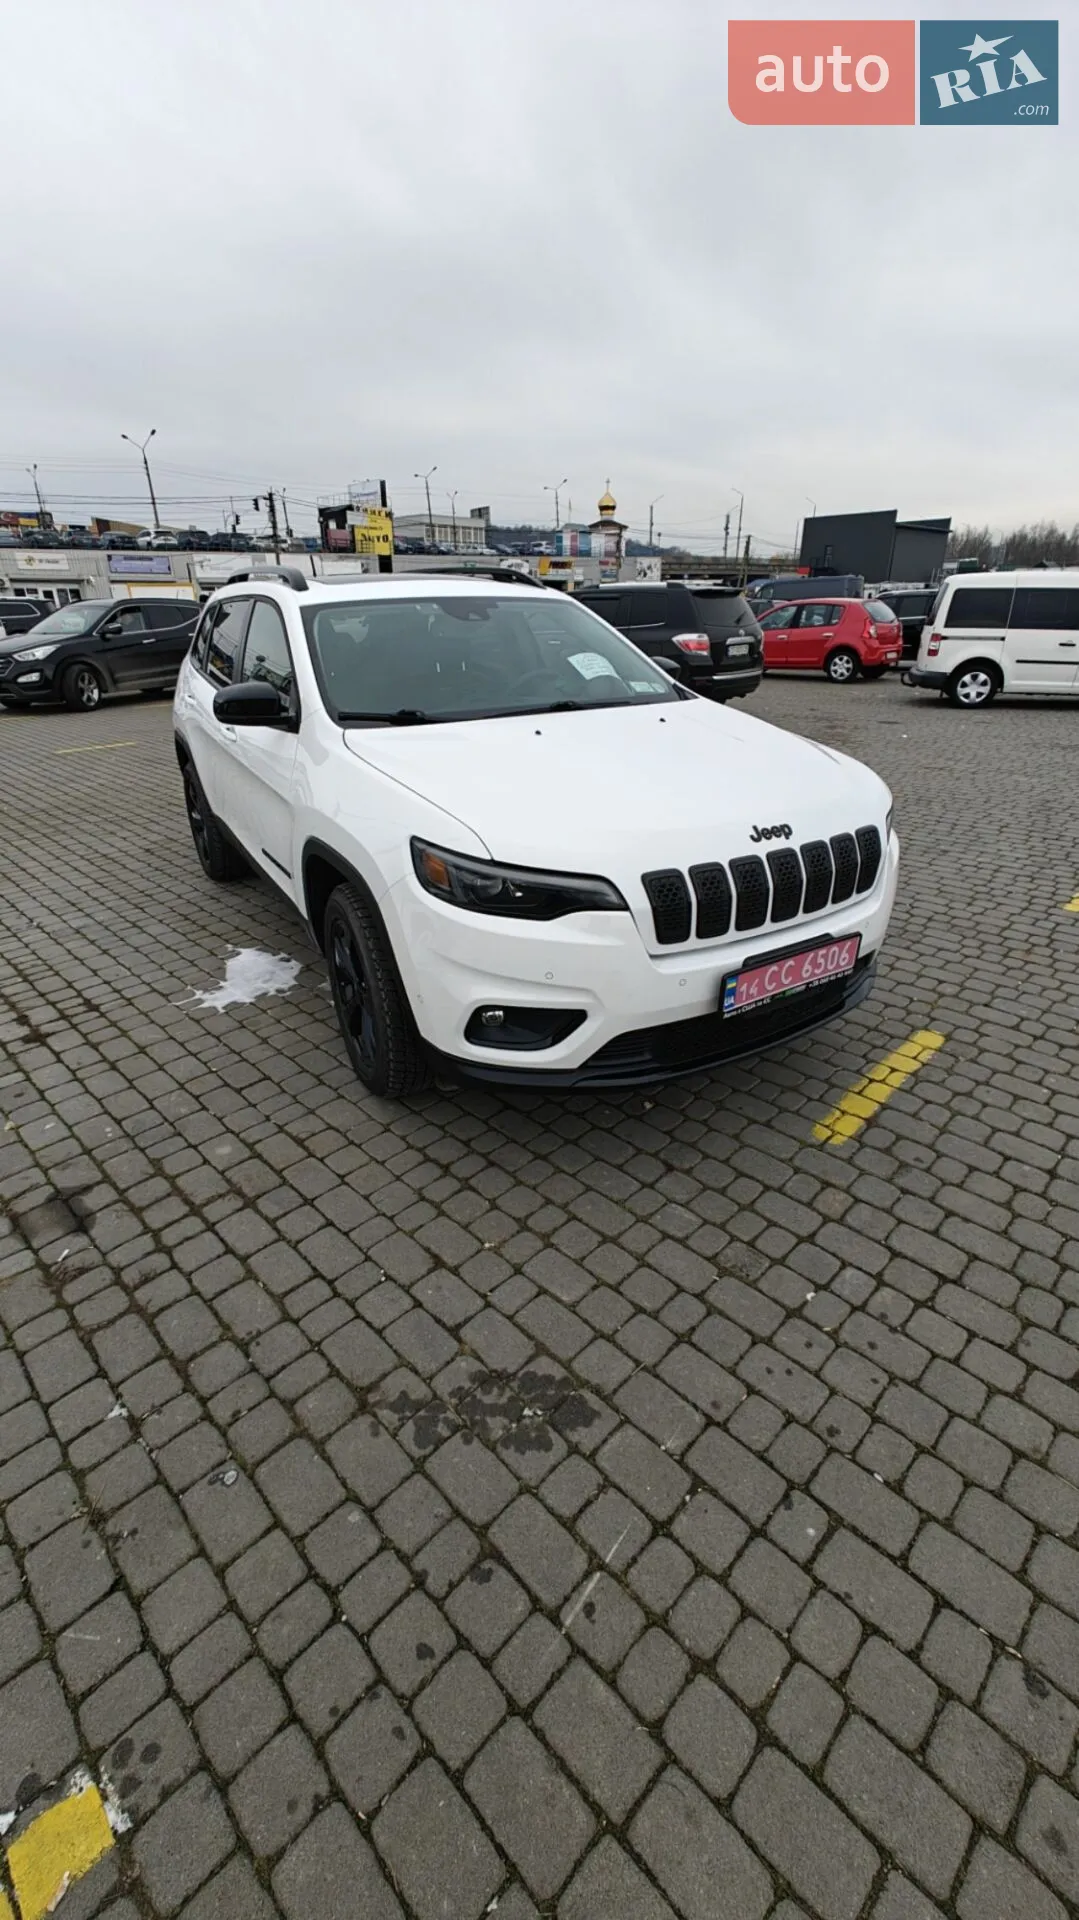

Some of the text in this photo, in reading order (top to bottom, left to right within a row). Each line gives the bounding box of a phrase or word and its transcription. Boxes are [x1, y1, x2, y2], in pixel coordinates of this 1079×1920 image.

[749, 823, 793, 843] Jeep
[740, 978, 759, 1001] 14
[765, 960, 795, 991] CC
[801, 942, 852, 979] 6506
